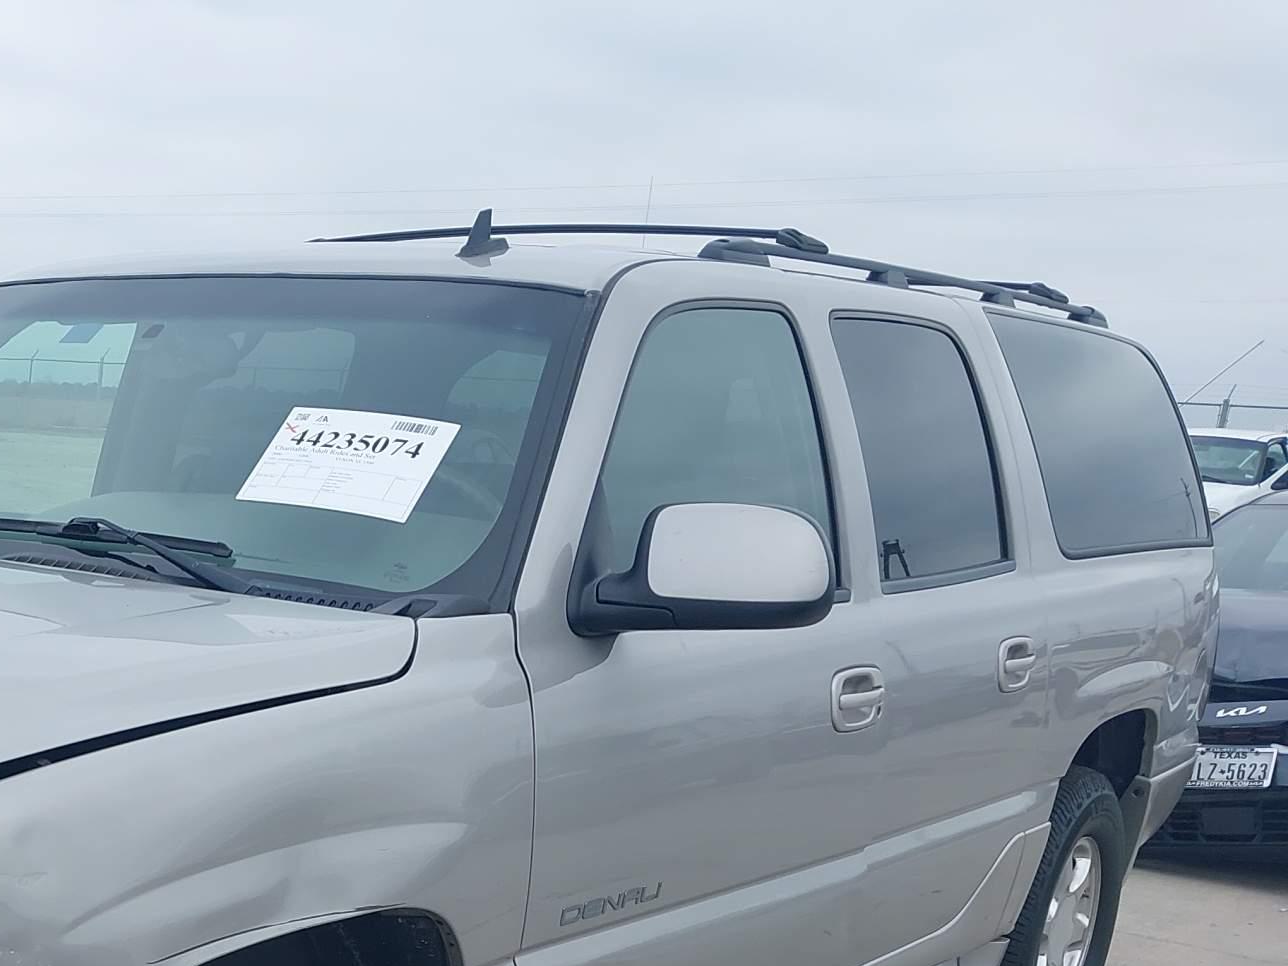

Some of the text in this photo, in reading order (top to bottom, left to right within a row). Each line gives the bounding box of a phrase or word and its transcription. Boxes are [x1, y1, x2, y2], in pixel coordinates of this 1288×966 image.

[291, 428, 425, 459] 44235074
[1213, 752, 1248, 760] TEXAS
[560, 881, 663, 927] DENALI
